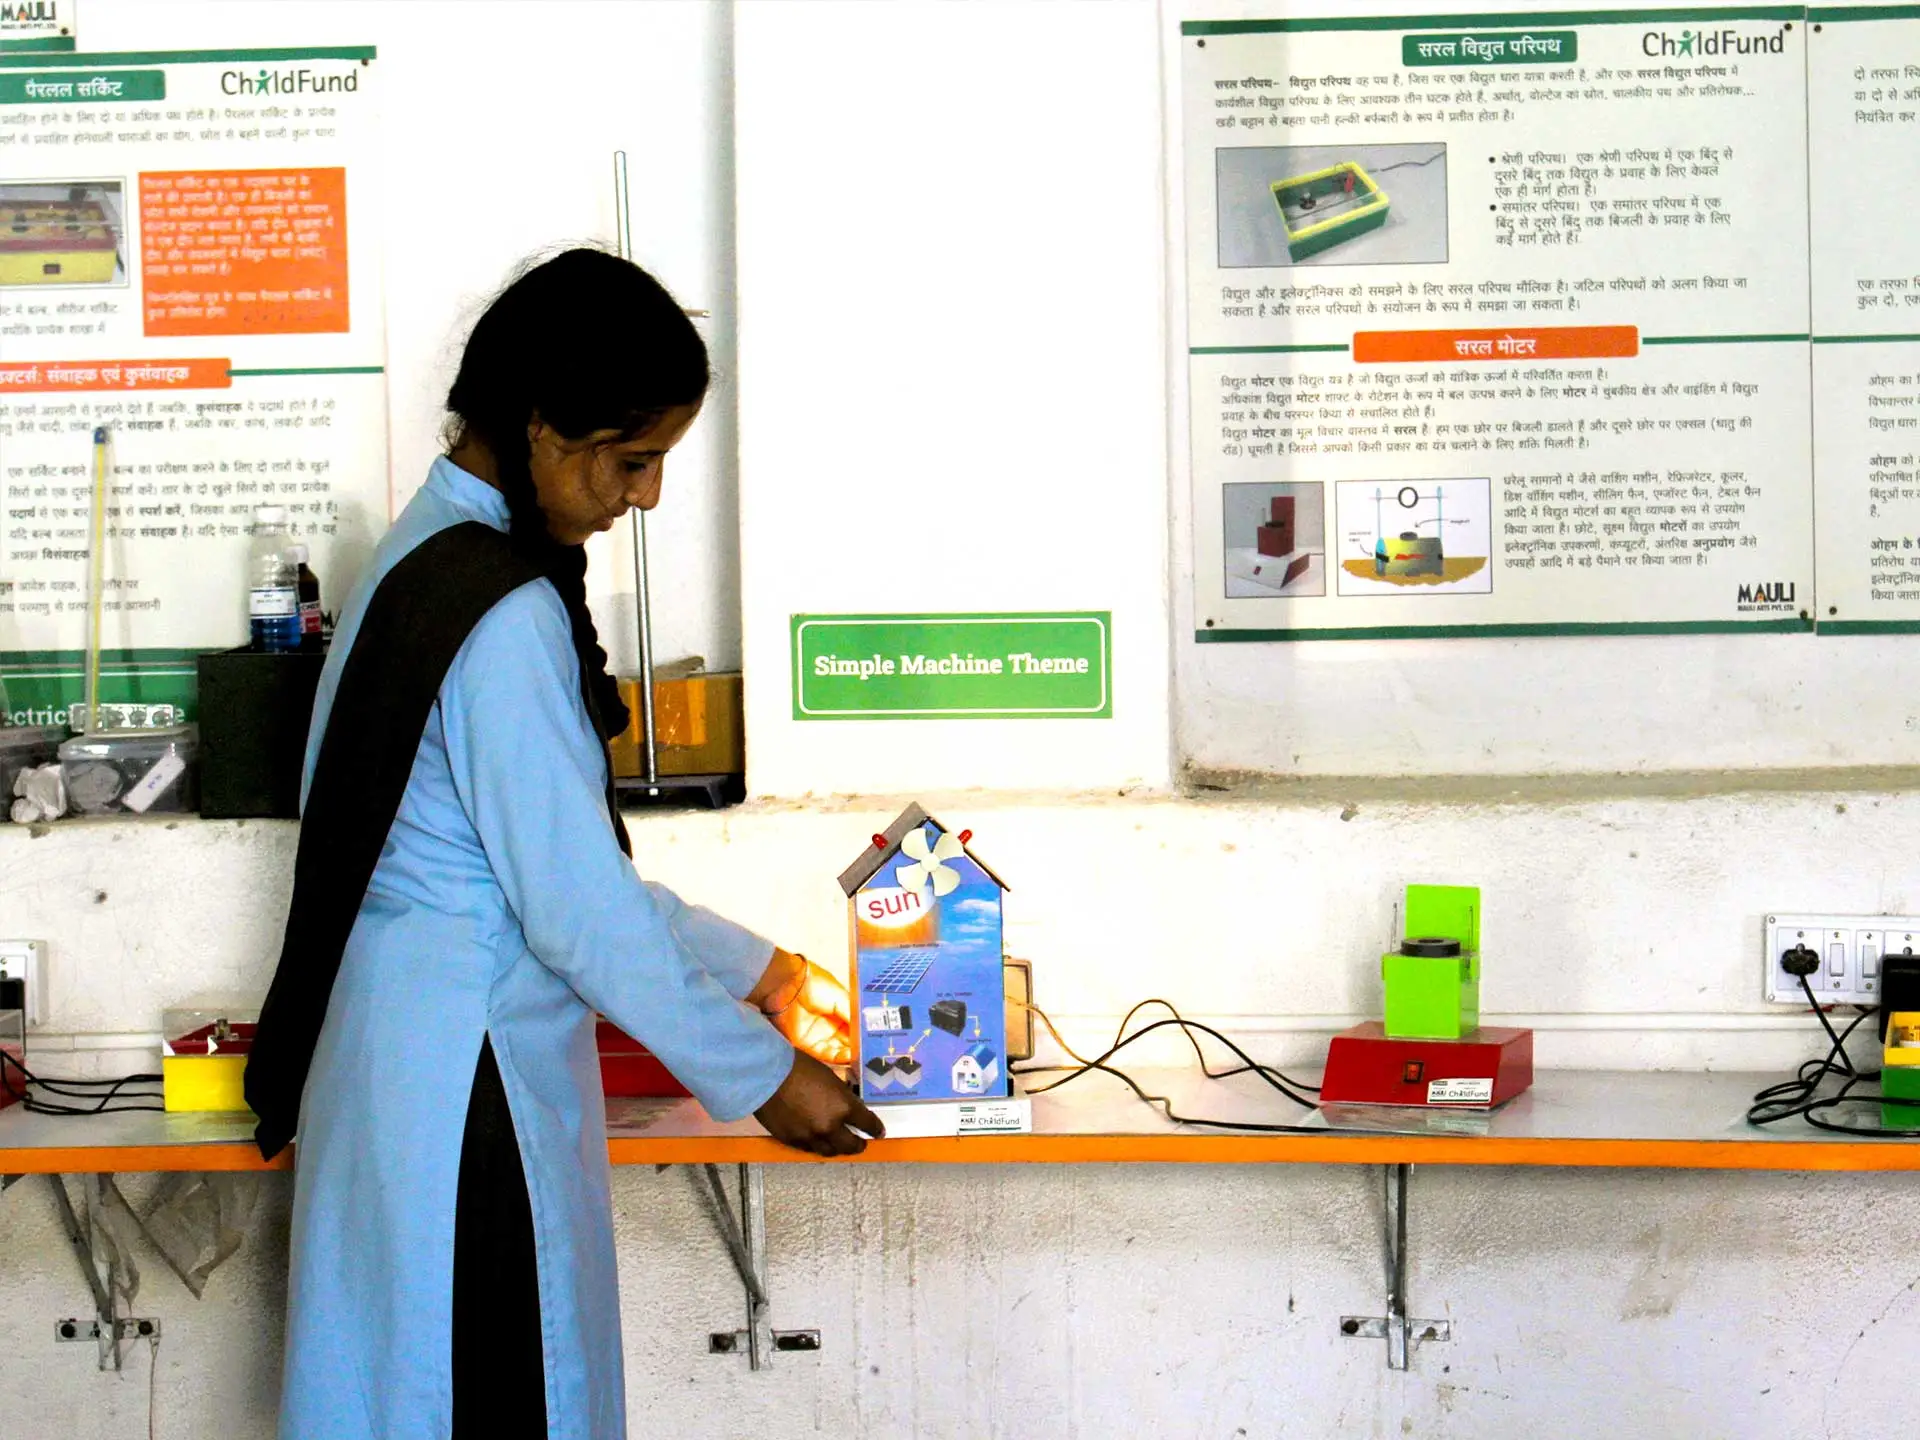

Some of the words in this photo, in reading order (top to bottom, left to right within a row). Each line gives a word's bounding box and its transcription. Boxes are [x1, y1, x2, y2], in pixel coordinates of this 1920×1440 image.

[1, 1, 56, 20] MAULI
[1417, 41, 1456, 57] सरल
[1460, 36, 1505, 61] विद्युत
[1509, 35, 1562, 55] परिपथ
[1642, 27, 1784, 58] ChildFund
[25, 79, 73, 98] पैरलल
[77, 76, 123, 96] सर्किट
[221, 69, 357, 96] ChildFund
[1455, 340, 1492, 355] सरल
[1497, 334, 1536, 354] मोटर
[1738, 582, 1795, 603] MAULI
[814, 654, 895, 680] Simple
[900, 653, 1003, 675] Machine
[1008, 652, 1090, 674] Theme
[868, 891, 921, 919] sun
